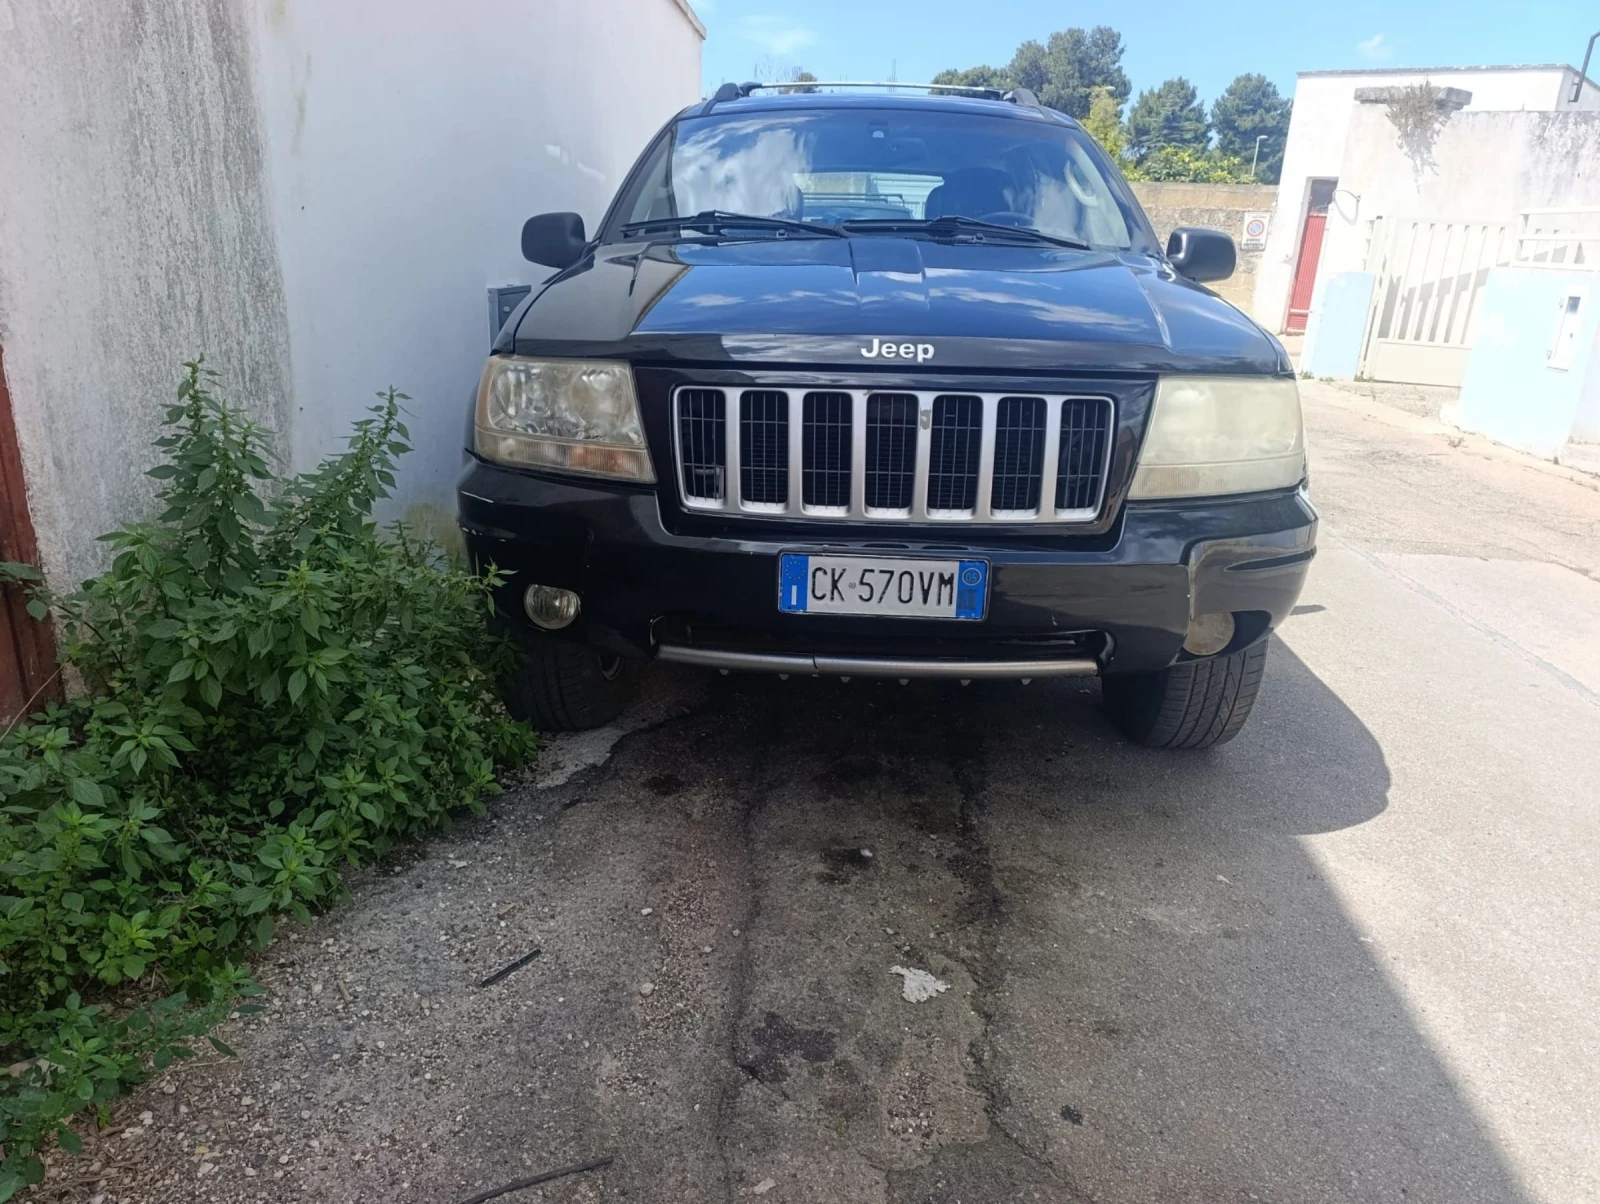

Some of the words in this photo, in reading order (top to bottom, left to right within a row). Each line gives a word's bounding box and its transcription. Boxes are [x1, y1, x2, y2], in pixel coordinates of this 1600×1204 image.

[860, 338, 935, 363] Jeep
[791, 584, 797, 606] I
[811, 566, 847, 602] CK
[858, 568, 955, 607] 570VM
